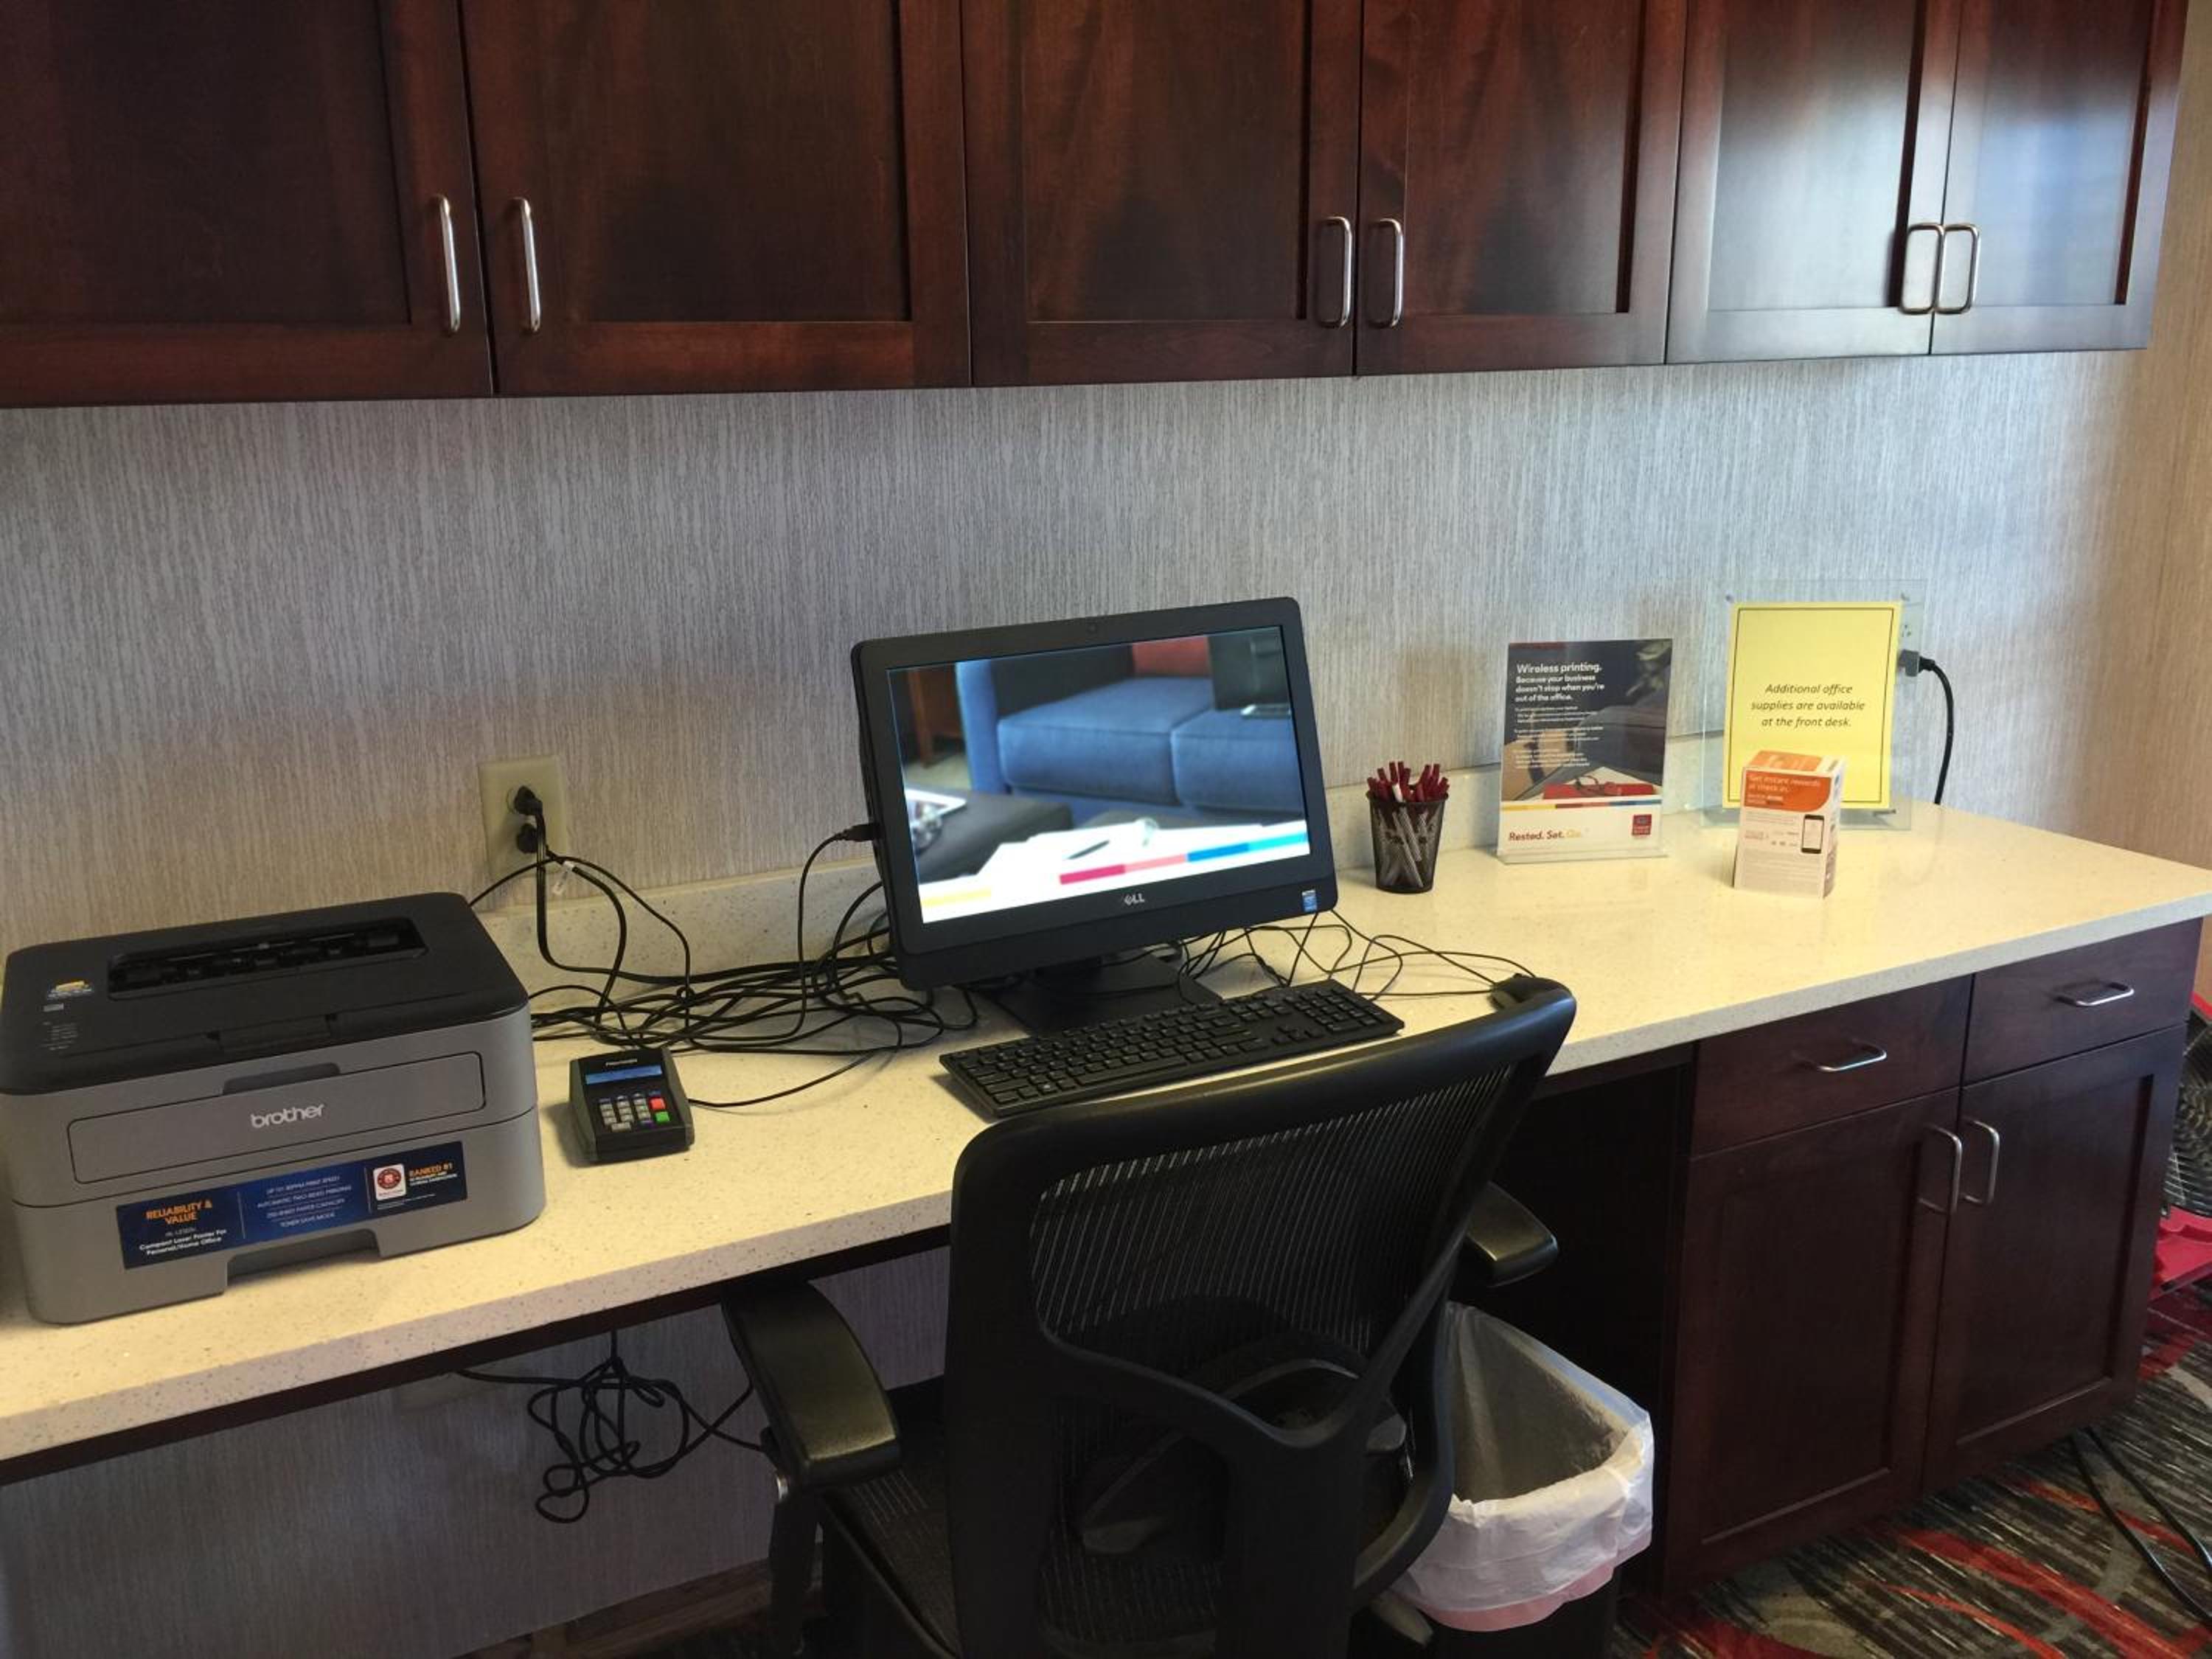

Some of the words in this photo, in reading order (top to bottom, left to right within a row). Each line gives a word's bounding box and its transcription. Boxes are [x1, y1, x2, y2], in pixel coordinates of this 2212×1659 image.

[1517, 663, 1559, 673] Wireless
[1560, 661, 1602, 674] printing.
[1515, 675, 1546, 684] Because
[1548, 676, 1563, 684] your
[1564, 674, 1596, 682] business
[1515, 684, 1543, 693] doesn't
[1544, 684, 1560, 692] stop
[1561, 683, 1582, 692] when
[1582, 681, 1605, 692] you're
[1765, 684, 1820, 694] Additional
[1823, 684, 1853, 695] office
[1528, 694, 1536, 702] of
[1550, 693, 1573, 701] office.
[1751, 700, 1793, 712] supplies
[1796, 702, 1815, 710] are
[1816, 700, 1865, 711] available
[1761, 718, 1773, 726] at
[1775, 717, 1793, 726] the
[1794, 717, 1823, 728] front
[1825, 717, 1851, 727] desk.
[1509, 830, 1545, 841] Rested.
[1547, 830, 1565, 840] Set.
[251, 1104, 324, 1129] brother
[145, 1201, 202, 1220] RELIABILITY
[165, 1212, 198, 1225] VALUE
[139, 1239, 172, 1251] Compact
[173, 1236, 192, 1245] Laser
[192, 1231, 215, 1241] Printer
[200, 1237, 222, 1245] Office
